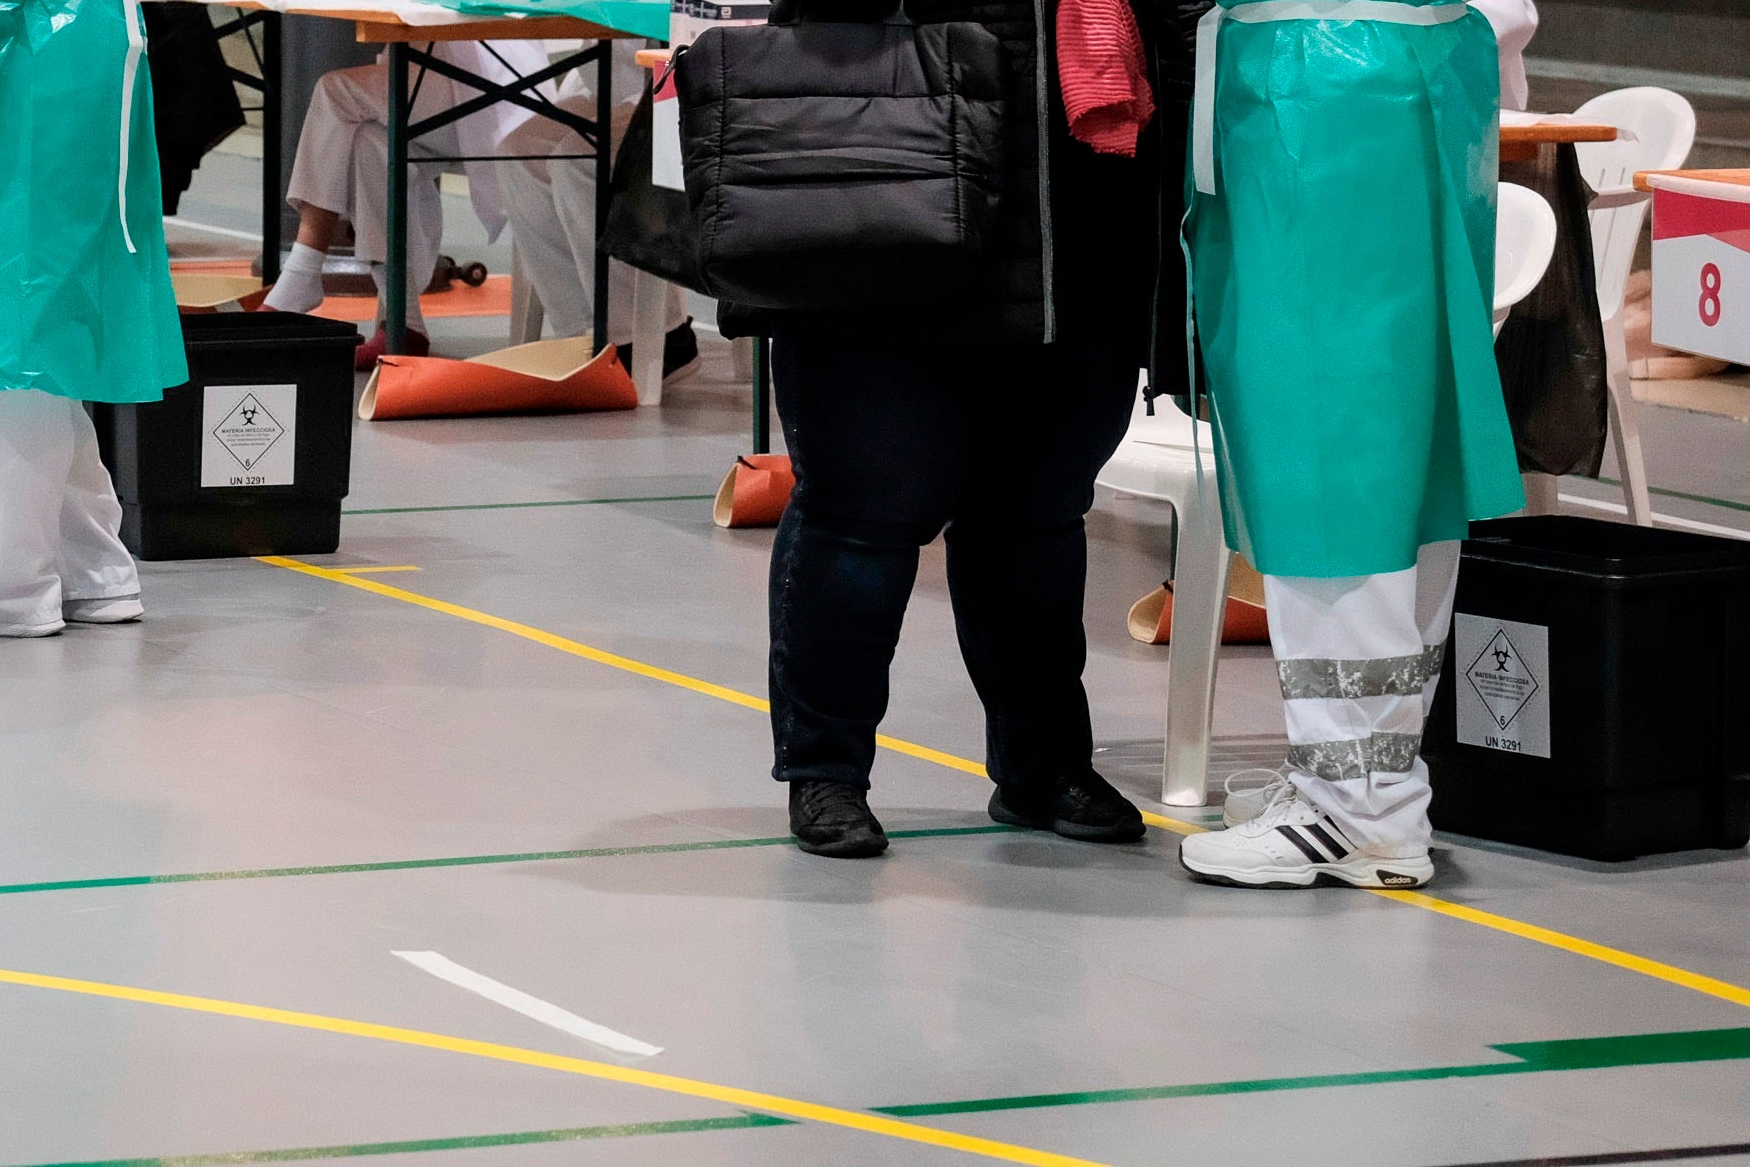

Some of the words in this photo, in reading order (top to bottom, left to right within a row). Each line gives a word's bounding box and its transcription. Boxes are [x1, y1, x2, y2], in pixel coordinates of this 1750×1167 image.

[1699, 262, 1721, 327] 8
[245, 458, 251, 467] 6
[230, 477, 243, 485] UN
[245, 476, 266, 485] 3291
[1500, 715, 1506, 726] 6
[1485, 736, 1499, 748] UN
[1501, 738, 1522, 751] 3291
[1384, 876, 1412, 884] adidas
